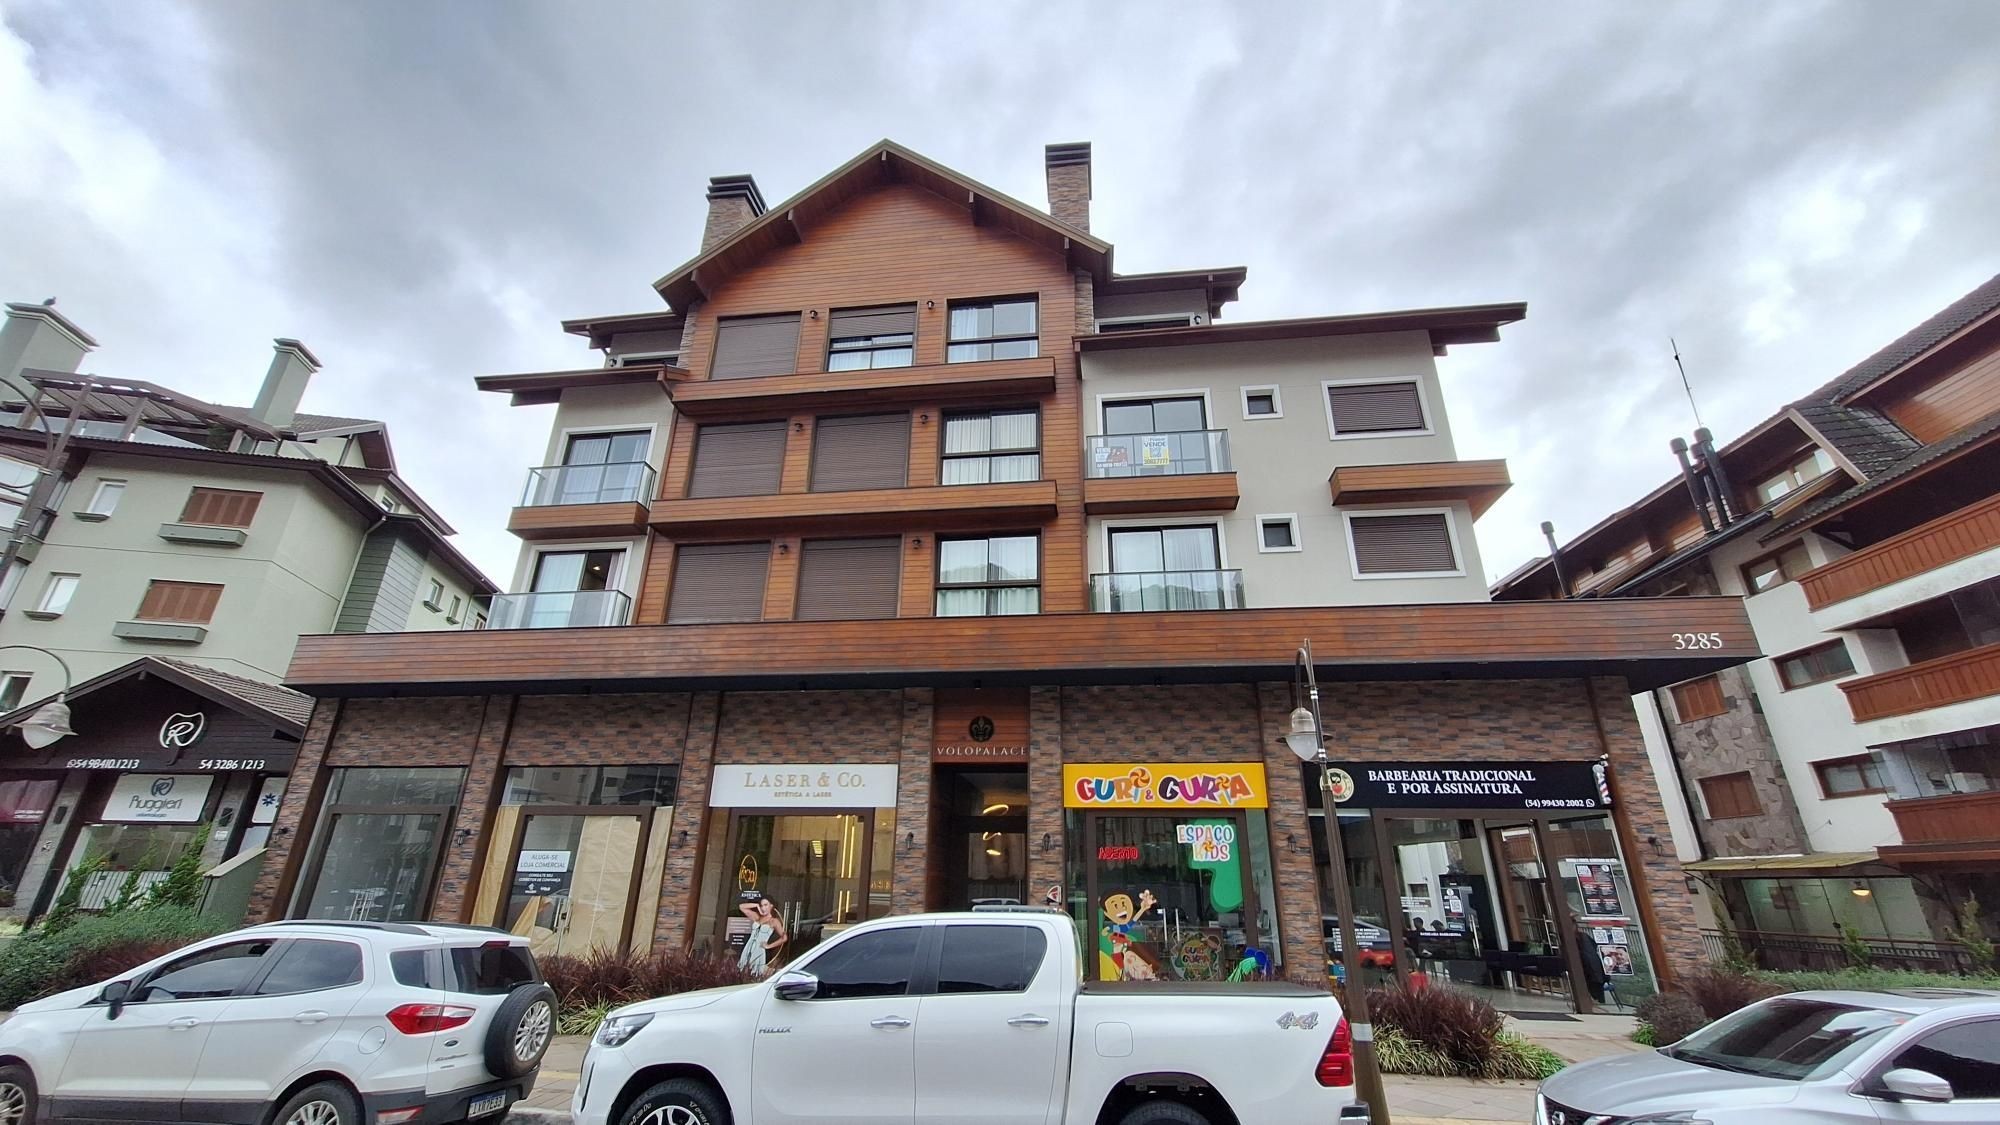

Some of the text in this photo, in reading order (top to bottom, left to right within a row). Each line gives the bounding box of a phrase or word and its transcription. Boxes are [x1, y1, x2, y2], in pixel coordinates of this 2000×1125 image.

[1671, 632, 1723, 650] 3285
[937, 746, 1025, 756] VOLOPALACE
[198, 759, 266, 770] 54 3286 1213
[743, 772, 811, 788] LASER
[817, 771, 830, 788] &
[1368, 770, 1536, 782] BARBEARIA TRADICIONAL
[1387, 783, 1523, 795] E POR ASSINATURA
[1525, 799, 1541, 808] (54)
[1566, 799, 1584, 807] 2002
[1177, 825, 1234, 845] ESPAÇO
